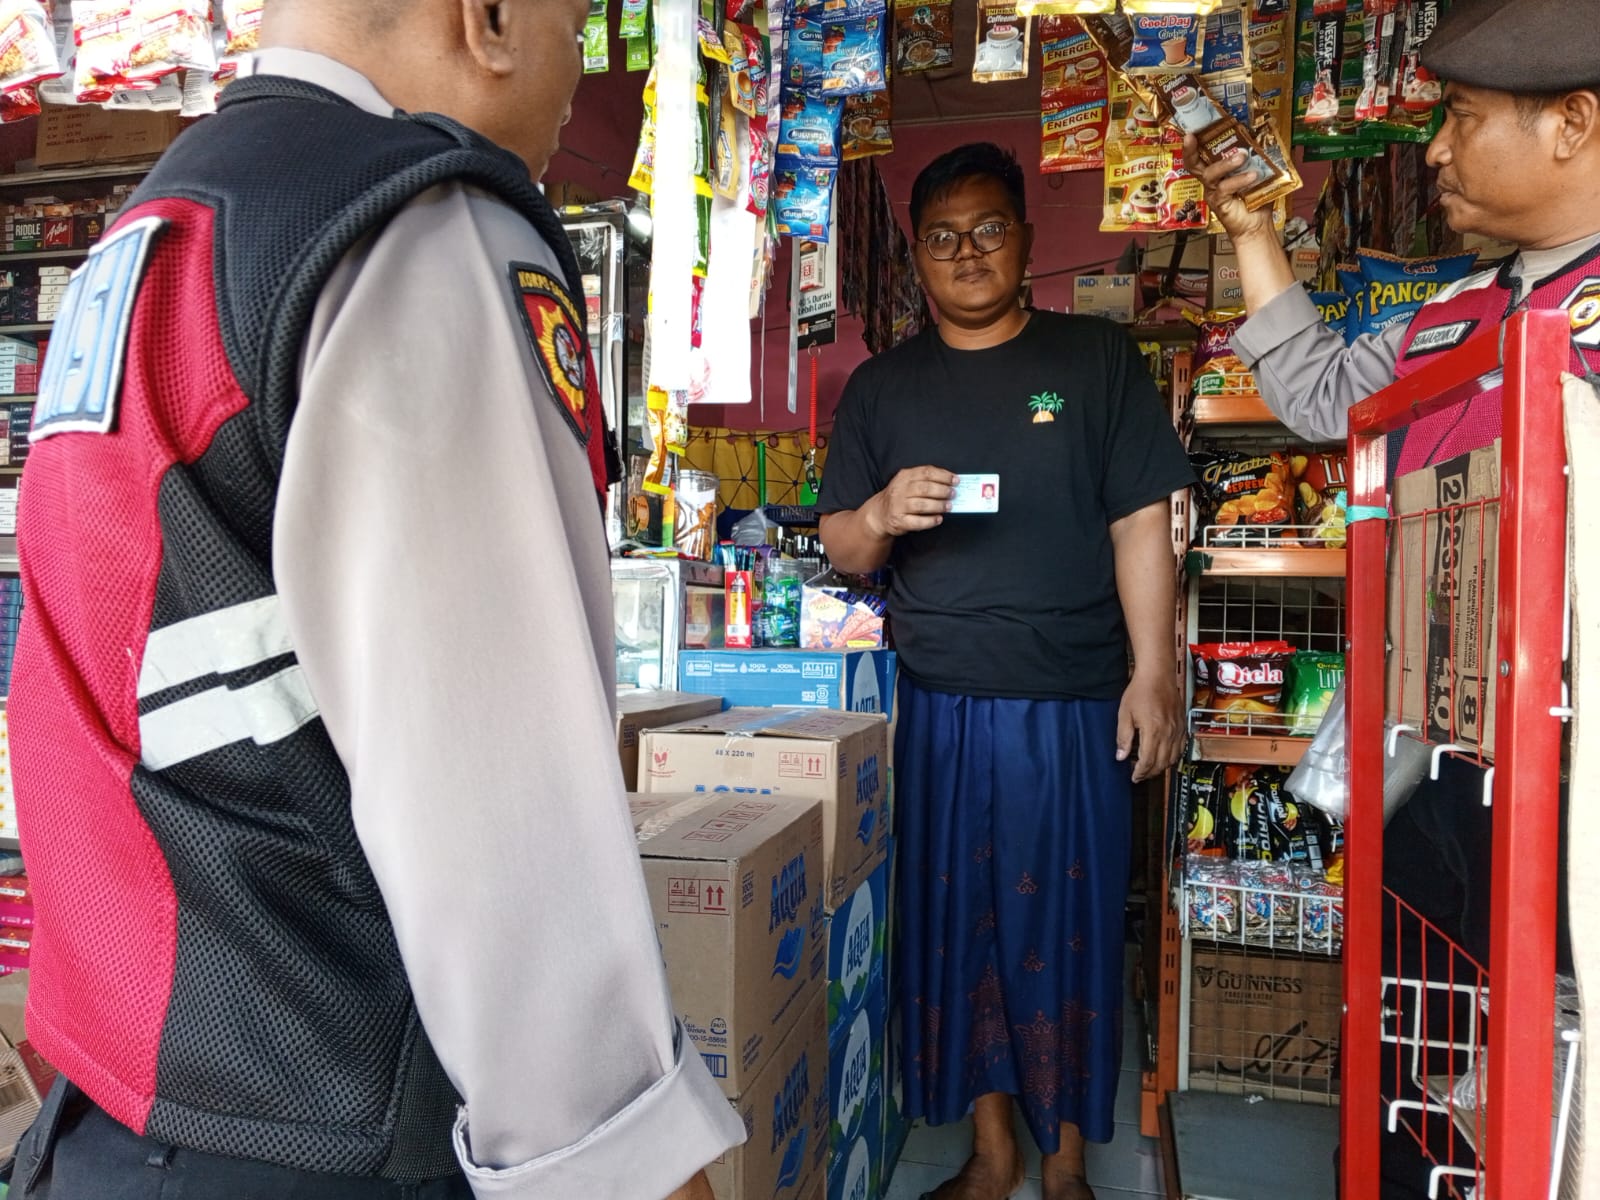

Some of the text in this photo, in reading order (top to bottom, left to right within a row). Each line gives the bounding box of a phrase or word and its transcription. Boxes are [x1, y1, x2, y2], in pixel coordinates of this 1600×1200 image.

[1139, 14, 1191, 29] Good Day
[1047, 109, 1099, 131] ENERGEN
[1113, 157, 1169, 178] ENERGEN
[15, 223, 41, 236] RIDDLE
[1077, 277, 1131, 288] INDILK
[1463, 696, 1478, 727] 8
[846, 911, 872, 978] AQUA
[1217, 970, 1303, 994] GUINNESS
[844, 1040, 868, 1114] AQUA
